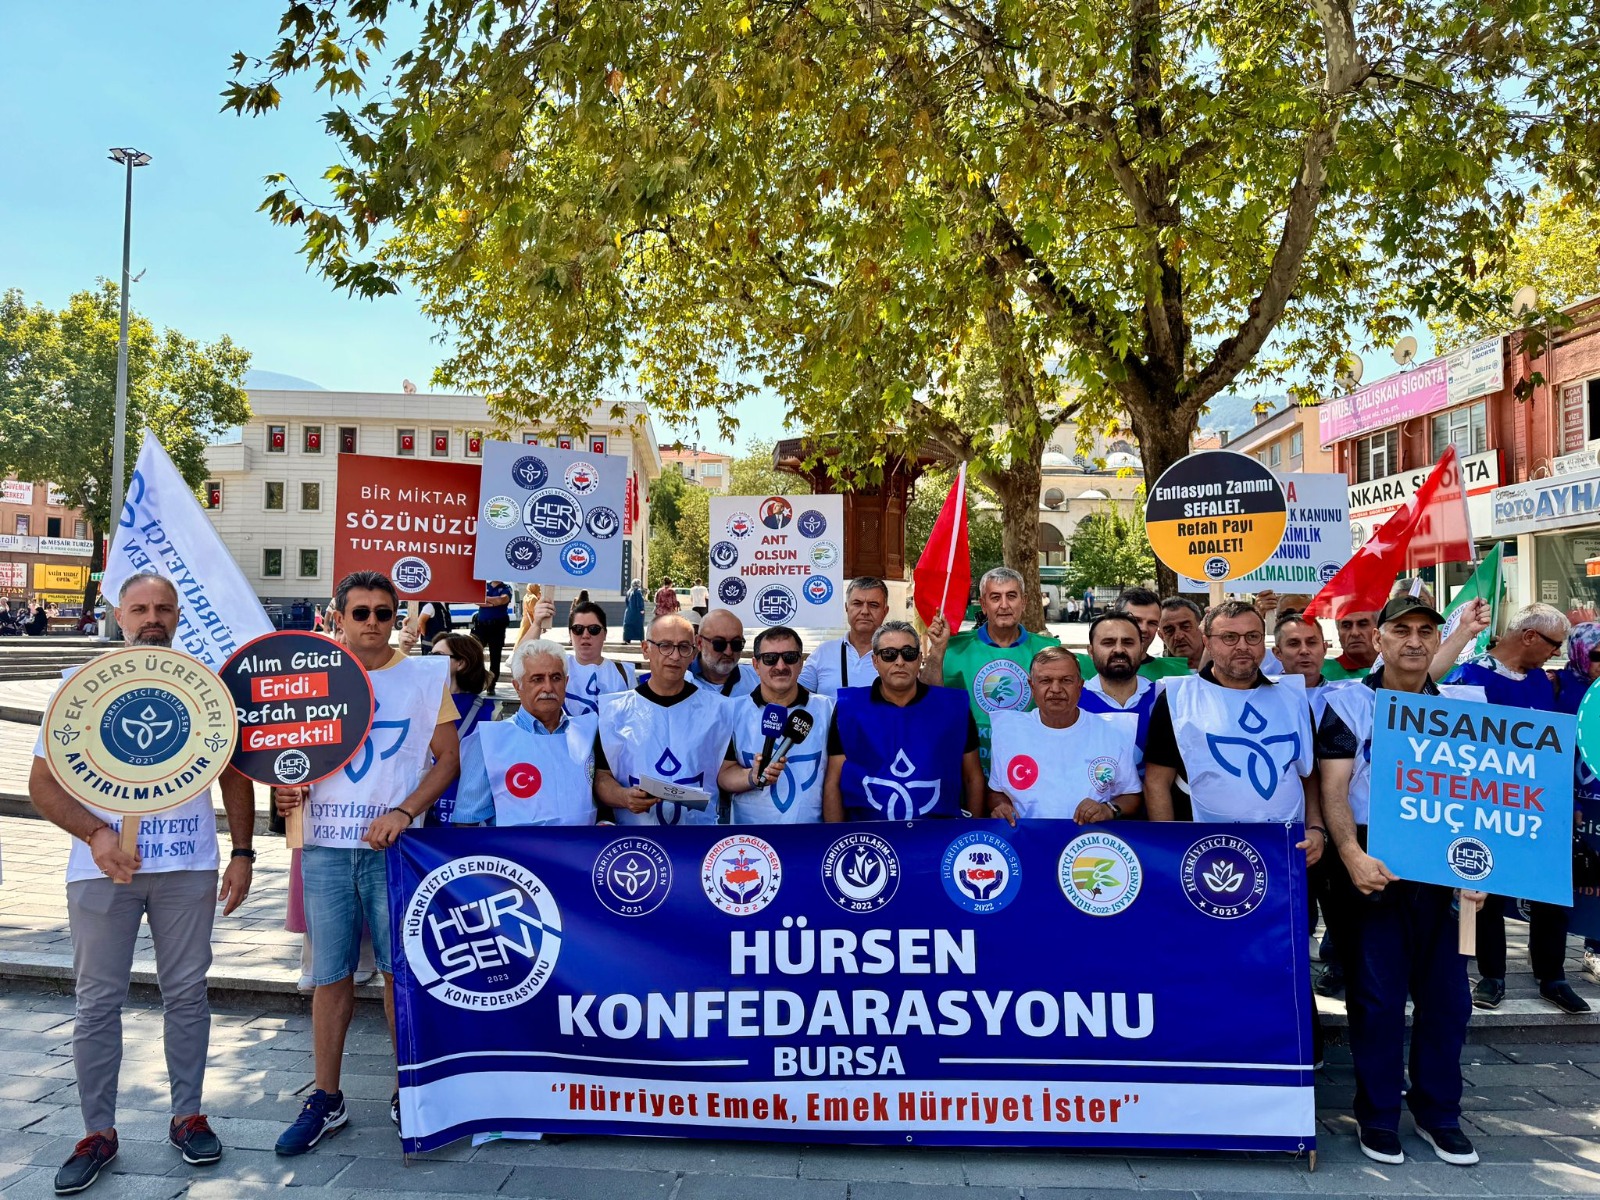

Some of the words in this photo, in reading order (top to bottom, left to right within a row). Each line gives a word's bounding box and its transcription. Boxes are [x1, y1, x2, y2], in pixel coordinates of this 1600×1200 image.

[1330, 399, 1355, 419] MUSA
[1356, 384, 1400, 414] ÇALIŞKAN
[1401, 366, 1445, 395] SİGORTA
[361, 484, 391, 500] BİR
[398, 487, 467, 506] MİKTAR
[1156, 482, 1223, 502] Enflasyon
[1226, 478, 1273, 495] Zammı
[535, 501, 576, 523] HÜR
[1299, 508, 1342, 523] KANUNU
[1495, 498, 1535, 519] FOTO
[346, 511, 477, 536] SÖZÜNÜZÜ
[531, 515, 572, 531] SEN
[1177, 521, 1218, 537] Refah
[1223, 519, 1253, 535] Payı
[350, 537, 473, 556] TUTARMISINIZ
[761, 535, 788, 545] ANT
[1188, 538, 1244, 556] ADALET!
[754, 550, 797, 561] OLSUN
[1272, 544, 1311, 560] ANUNU
[398, 574, 424, 584] SEN
[740, 562, 812, 576] HÜRRİYETE
[760, 605, 789, 615] SEN
[762, 595, 790, 606] HÜR
[236, 653, 282, 675] Alım
[290, 650, 342, 669] Gücü
[64, 696, 88, 721] EK
[82, 659, 137, 694] DERS
[144, 654, 227, 730] ÜCRETLERİ
[260, 677, 317, 697] Eridi,
[102, 688, 151, 729] HÜRRİYETÇİ
[154, 689, 189, 733] EĞİTİM-SEN
[237, 705, 288, 724] Refah
[306, 702, 349, 723] payı
[792, 716, 811, 731] BURS
[1387, 696, 1563, 754] İNSANCA
[249, 727, 334, 749] Gerekti!
[128, 757, 154, 765] 2021
[1407, 736, 1536, 779] YAŞAM
[65, 750, 212, 800] ARTIRILMALIDIR
[279, 765, 303, 776] SEN
[1395, 760, 1545, 812] İSTEMEK
[1400, 796, 1465, 834] SUÇ
[1475, 807, 1543, 840] MU?
[704, 837, 736, 872] HÜRRİYET
[738, 836, 769, 852] SAĞLIK
[767, 851, 780, 871] SEN
[1071, 835, 1101, 854] TARIM
[1102, 836, 1134, 866] ORMAN
[597, 840, 633, 886] HÜRRİYETÇİ
[636, 841, 664, 865] EĞİTİM
[659, 865, 668, 887] SEN
[824, 834, 858, 878] HÜRRİYETÇİ
[859, 835, 898, 878] ULAŞIM-SEN
[943, 833, 980, 879] HÜRRİYETÇİ
[982, 833, 1020, 877] YEREL-SEN
[1182, 836, 1226, 893] HÜRRİYETÇİ
[1228, 838, 1259, 865] BÜRO
[1254, 870, 1265, 896] SEN
[1454, 857, 1484, 871] SEN
[1060, 851, 1091, 912] HÜRRİYETÇİ
[1111, 864, 1138, 913] SENDİKASI
[407, 865, 456, 937] HÜRRİYETÇİ
[458, 860, 541, 896] SENDİKALAR
[620, 904, 643, 913] 2021
[725, 903, 759, 914] 2022
[850, 901, 873, 910] 2022
[973, 903, 995, 912] 2022
[427, 888, 543, 951] HÜR
[1211, 906, 1239, 916] 2022
[440, 922, 536, 982] SEN
[730, 915, 977, 976] HÜRSEN
[444, 959, 550, 1006] KONFEDERASYONU
[487, 973, 510, 984] 2023
[557, 989, 1156, 1040] KONFEDARASYONU
[773, 1046, 906, 1077] BURSA
[706, 1092, 799, 1123] Emek,
[806, 1092, 889, 1121] Emek
[898, 1092, 1034, 1125] Hürriyet
